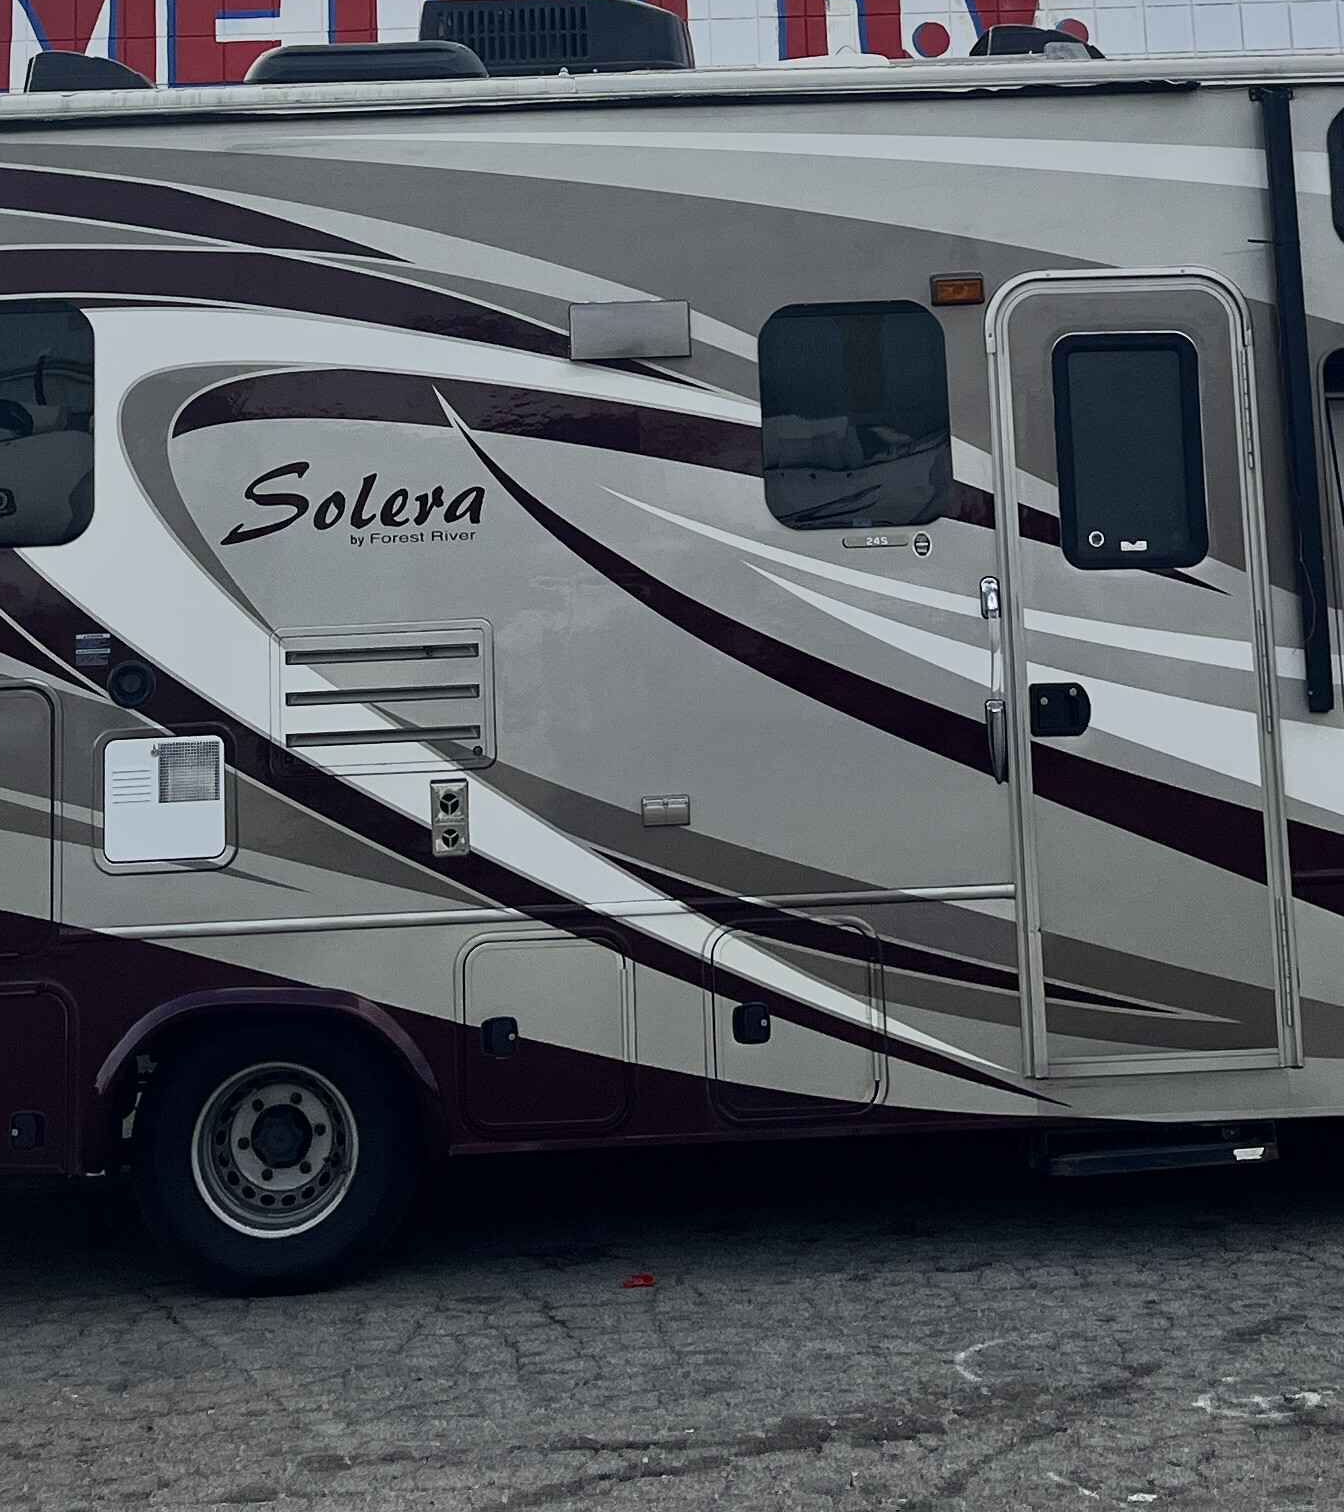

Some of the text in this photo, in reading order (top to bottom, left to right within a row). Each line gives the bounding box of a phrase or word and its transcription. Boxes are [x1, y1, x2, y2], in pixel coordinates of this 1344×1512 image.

[220, 461, 485, 545] Solera
[350, 530, 476, 547] by Forest River
